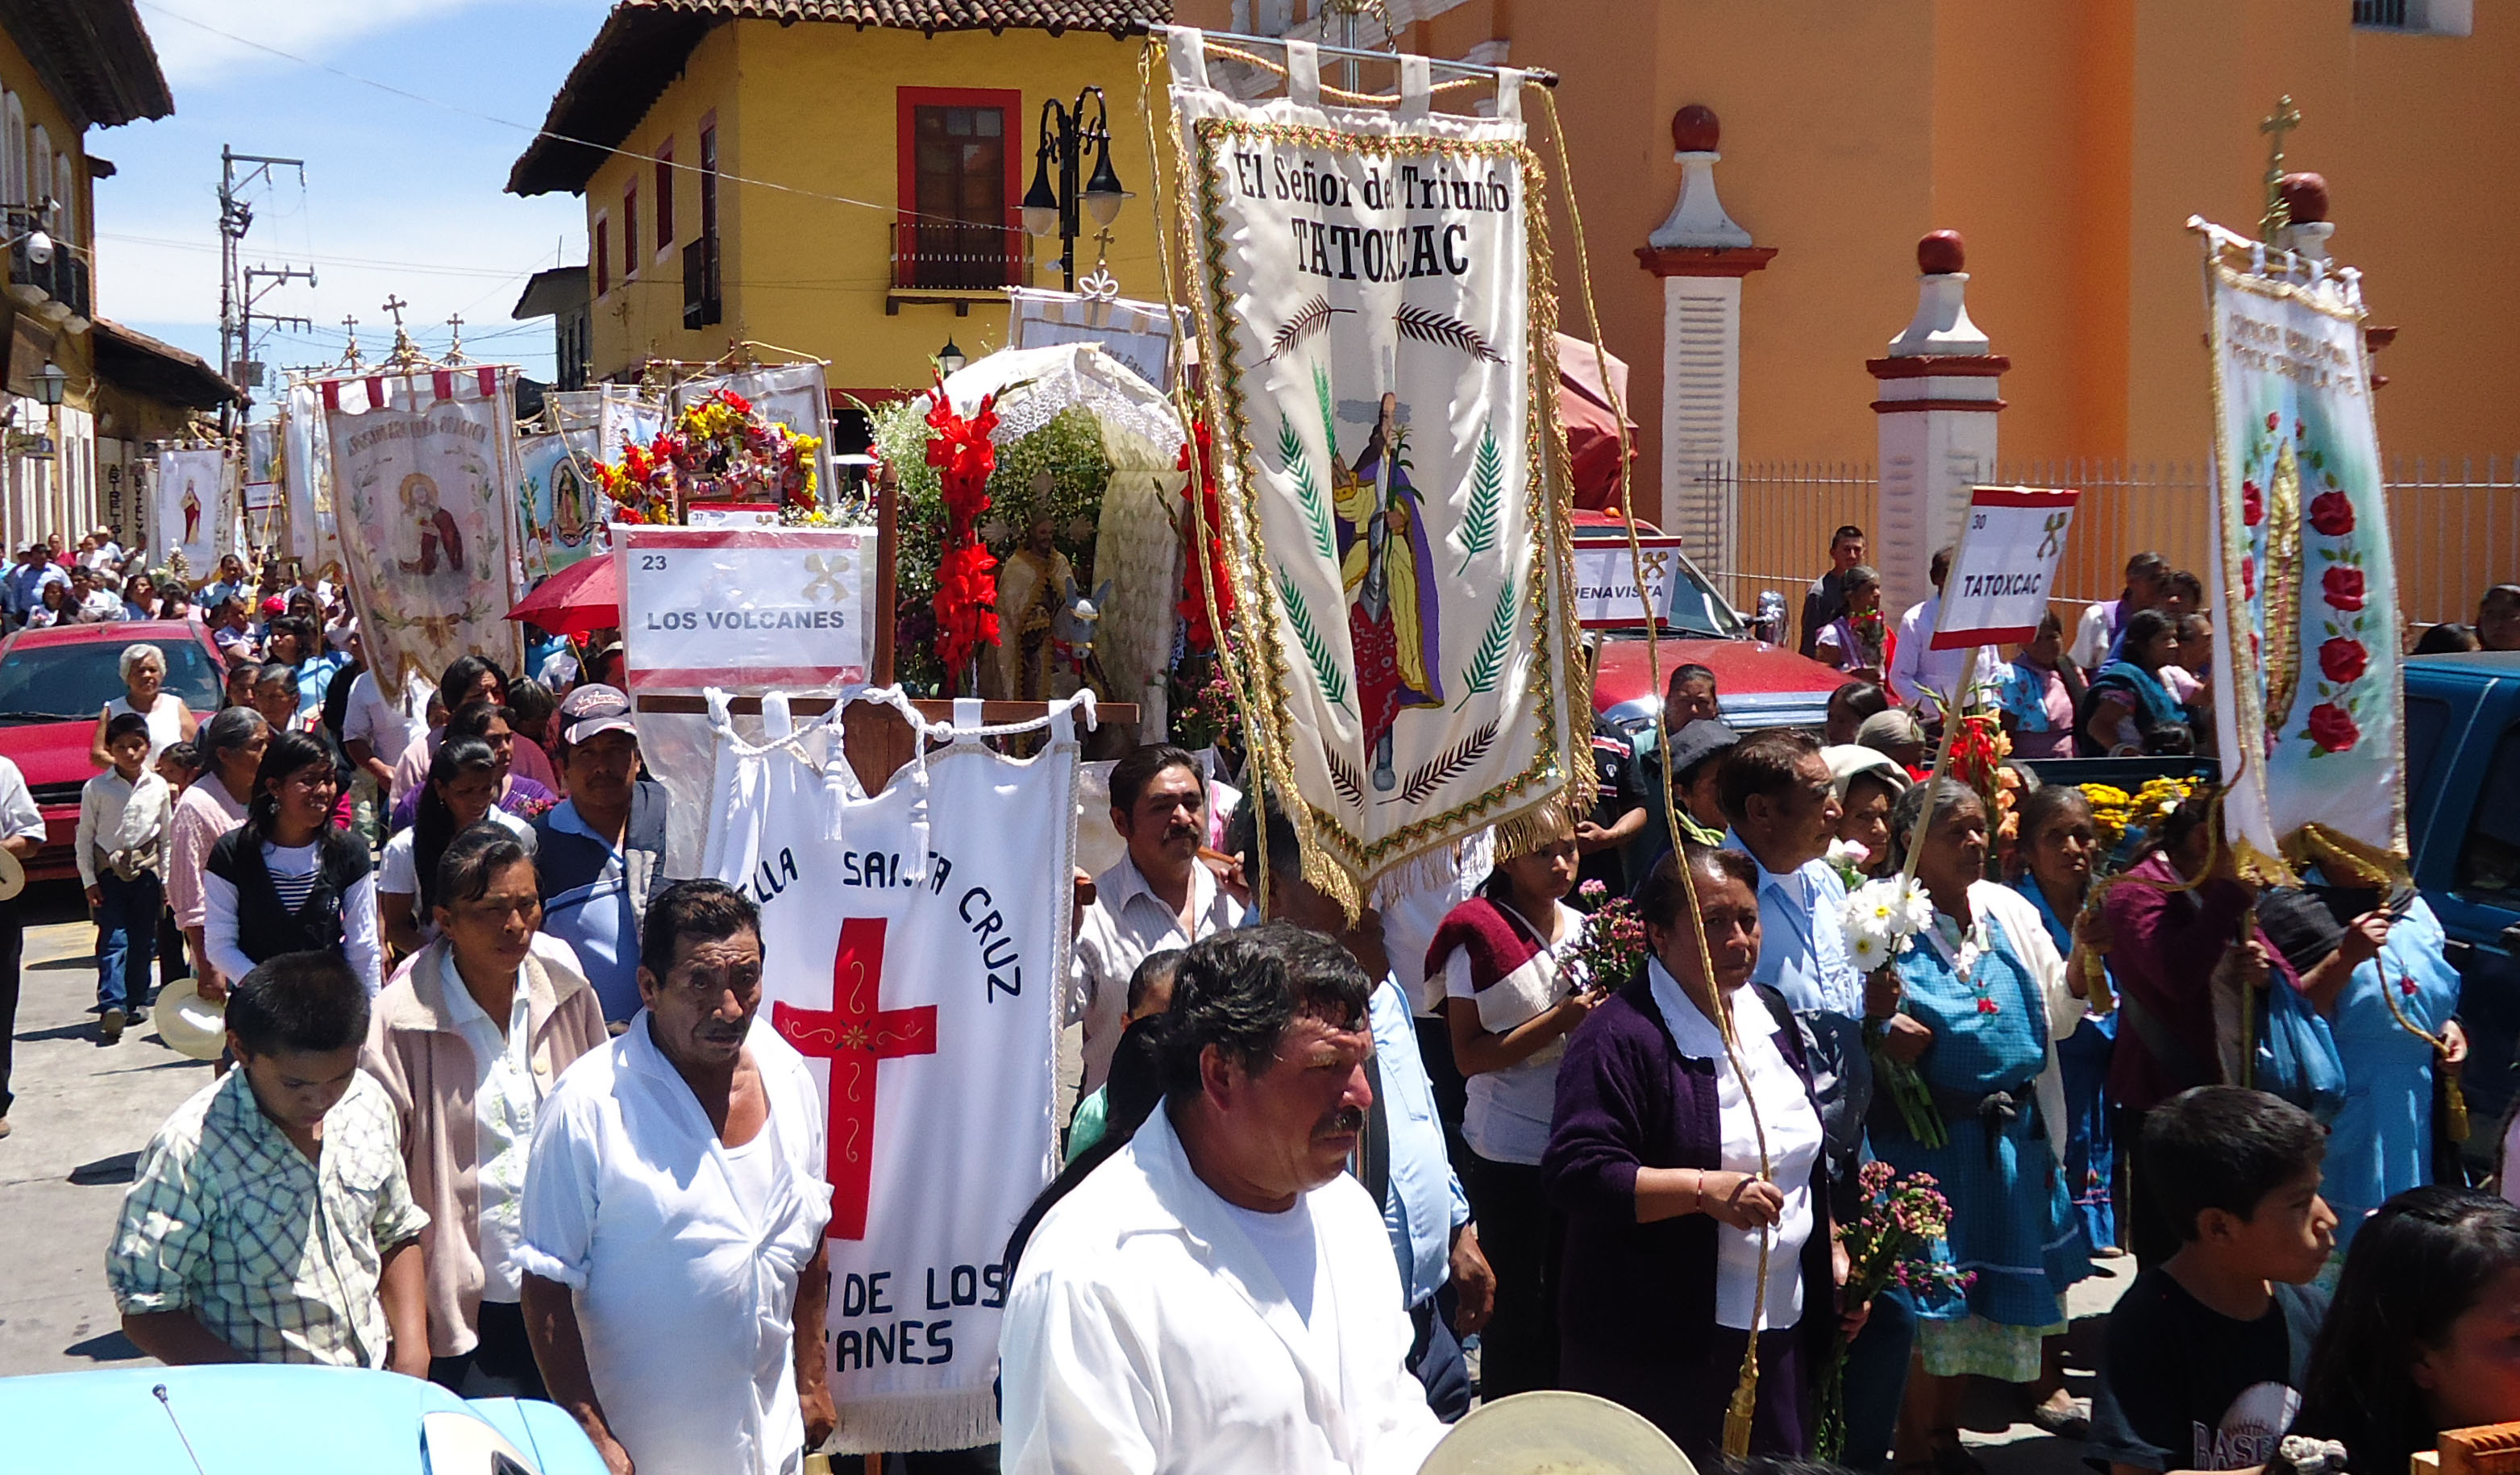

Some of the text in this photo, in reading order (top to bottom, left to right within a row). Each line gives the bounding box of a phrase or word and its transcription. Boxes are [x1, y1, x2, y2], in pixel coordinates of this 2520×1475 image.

[1233, 152, 1267, 199] El
[1275, 157, 1354, 209] Señor
[1402, 164, 1511, 214] Triunfo
[1291, 218, 1470, 283] TATOXCAC
[1972, 514, 1987, 530] 30
[642, 555, 667, 571] 23
[1964, 573, 2042, 598] TATOXCAC
[647, 610, 845, 630] LOS VOLCANES
[959, 886, 1022, 1005] CRUZ
[842, 1271, 893, 1318] DE
[926, 1264, 1004, 1311] LOS
[825, 1319, 954, 1373] ANES
